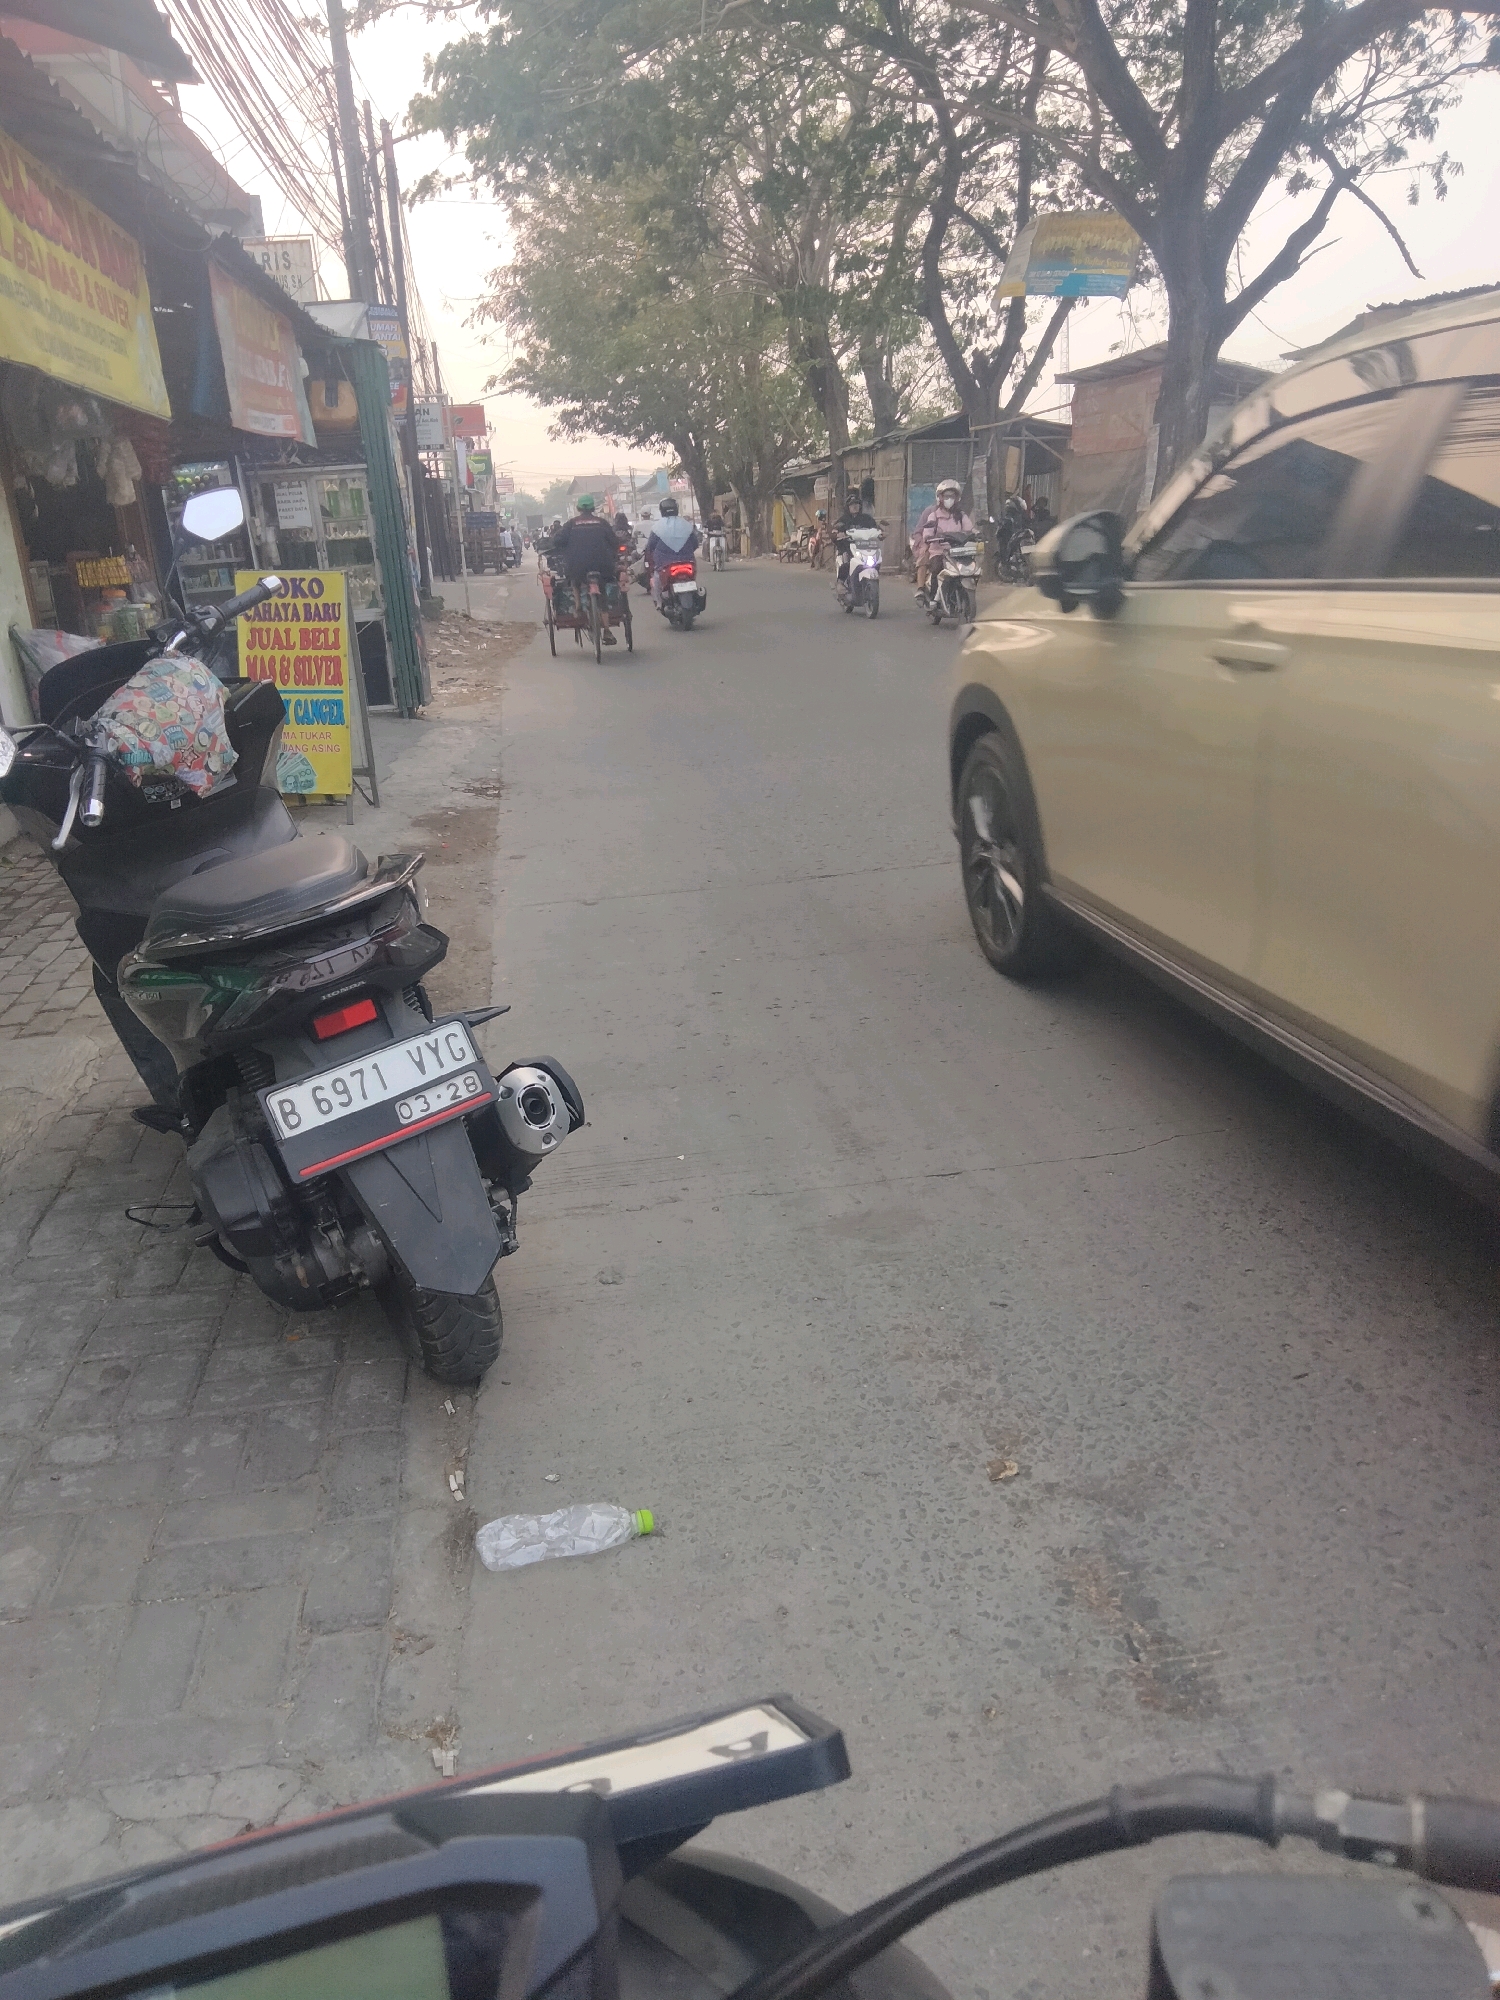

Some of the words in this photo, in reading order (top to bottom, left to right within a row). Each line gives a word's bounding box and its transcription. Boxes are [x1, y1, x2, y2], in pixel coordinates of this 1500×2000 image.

[370, 323, 398, 331] UMAH
[374, 333, 401, 341] ANTAI
[258, 577, 324, 599] OKO
[302, 602, 341, 622] BARU
[246, 627, 296, 650] JUAL
[299, 627, 341, 650] BELI
[245, 654, 277, 685] MAS
[279, 654, 290, 686] &
[293, 654, 343, 686] SILVER
[293, 698, 346, 726] CANGER
[299, 731, 332, 741] TUKAR
[281, 743, 309, 753] UANG
[311, 743, 341, 753] ASING
[322, 980, 367, 1000] HONDA
[278, 1098, 301, 1130] B
[311, 1062, 388, 1116] 6971
[406, 1033, 466, 1076] VYG
